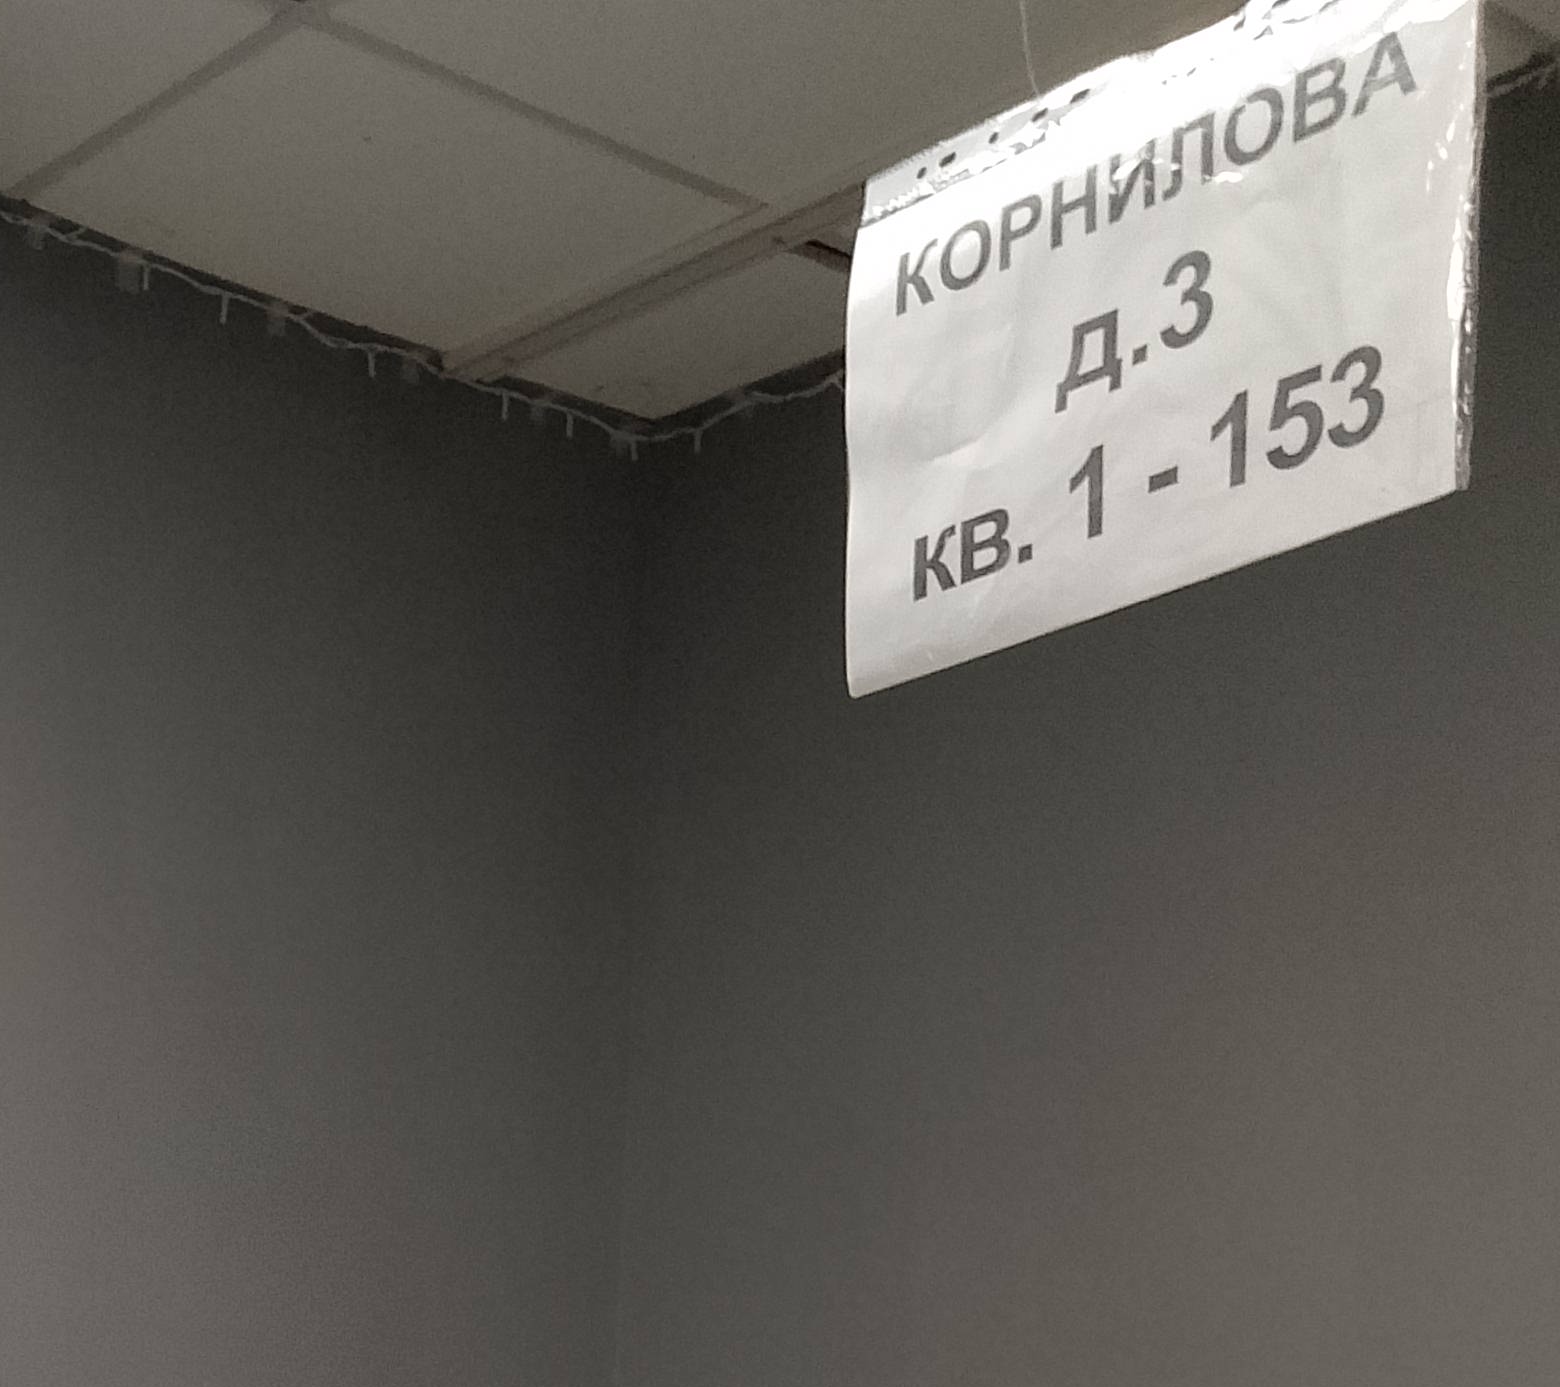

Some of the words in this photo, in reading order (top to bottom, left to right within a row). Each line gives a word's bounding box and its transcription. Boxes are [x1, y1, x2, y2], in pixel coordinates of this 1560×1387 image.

[895, 31, 1418, 316] КОРНИЛОВА
[1068, 444, 1105, 540] 1
[1209, 344, 1385, 489] 153
